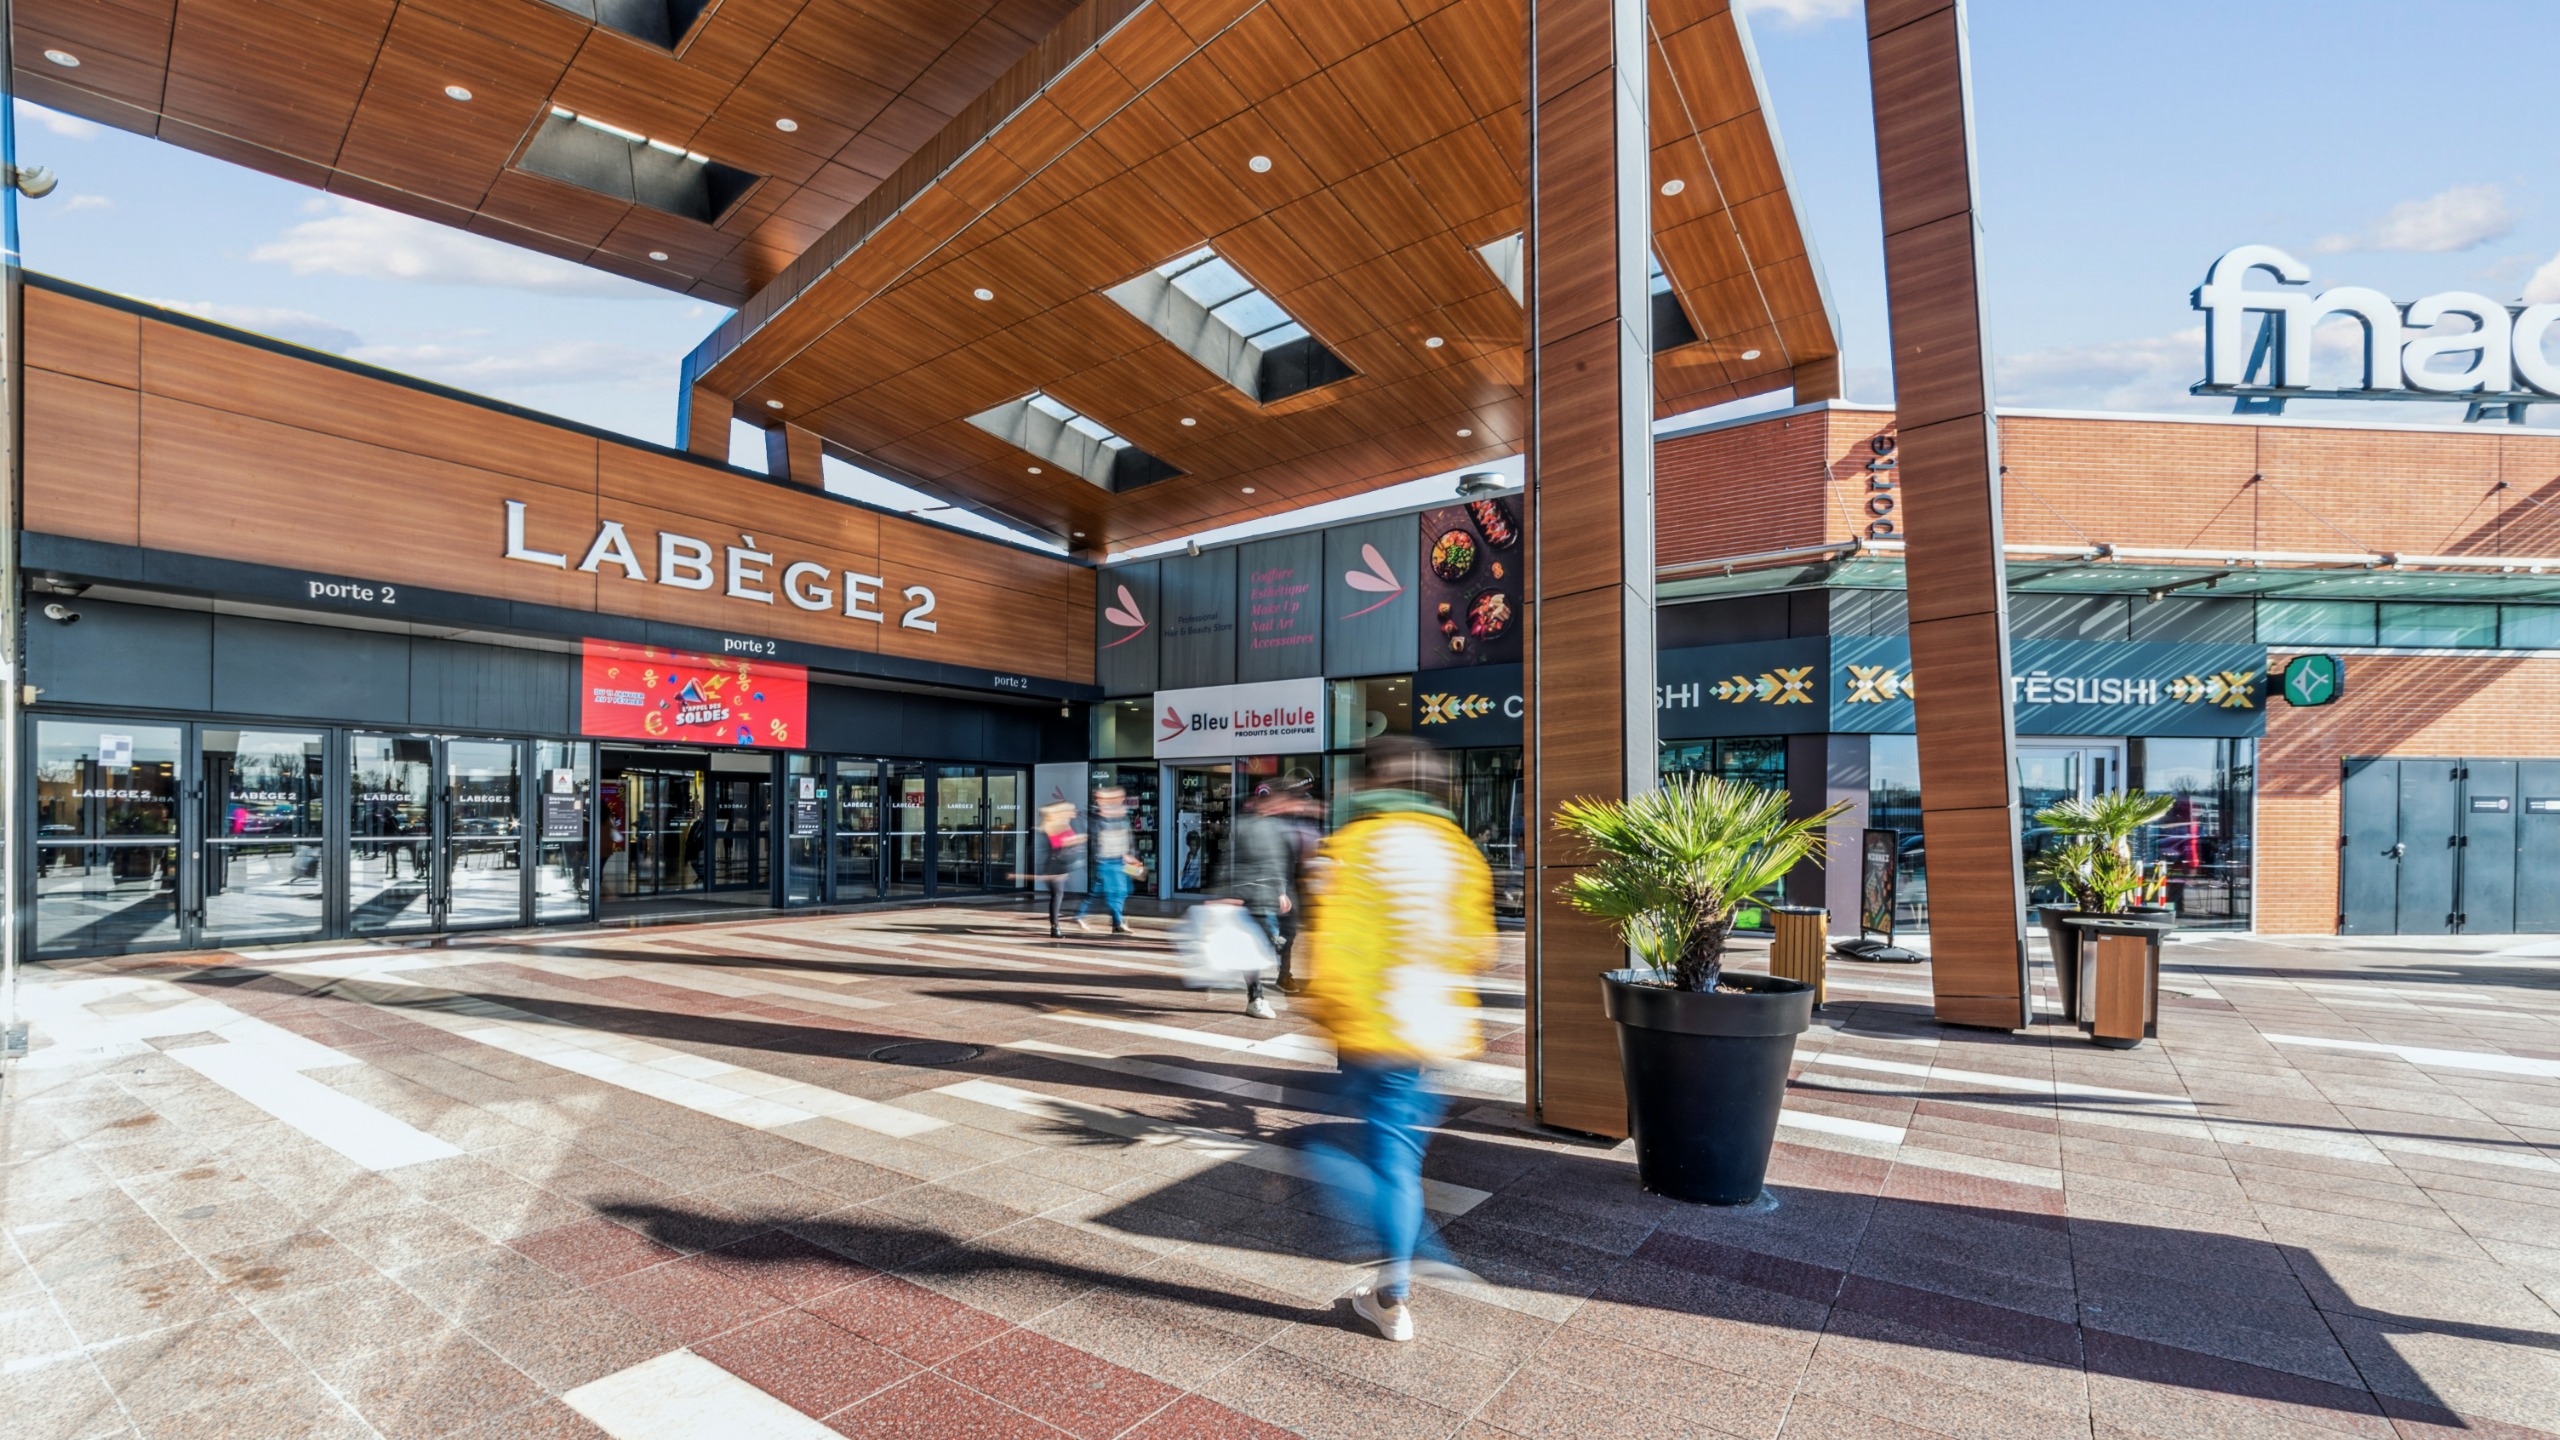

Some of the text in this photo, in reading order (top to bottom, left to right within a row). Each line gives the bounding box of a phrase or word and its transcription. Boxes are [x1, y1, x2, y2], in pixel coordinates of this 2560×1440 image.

[1866, 435, 1903, 540] porte
[504, 500, 938, 633] LABÈGE 2
[1250, 568, 1294, 584] Coiffure
[309, 581, 396, 604] porte 2
[1250, 582, 1310, 600] Esthétique
[1250, 600, 1299, 616] Make Up
[1178, 612, 1218, 624] Professional
[1250, 617, 1294, 633] Nail Art
[1164, 622, 1233, 638] Hair & Beauty Store
[724, 638, 776, 655] porte 2
[1250, 633, 1314, 650] Accessoires
[994, 676, 1027, 688] porte 2
[594, 688, 606, 696] DU
[614, 690, 645, 699] JANVIER
[675, 708, 730, 725] SOLDES
[1192, 706, 1315, 731] Bleu Libellule
[1235, 729, 1267, 737] PRODUITS
[1281, 727, 1315, 735] COIFFURE
[141, 790, 151, 799] 2
[288, 792, 297, 800] 2
[503, 795, 511, 803] 2
